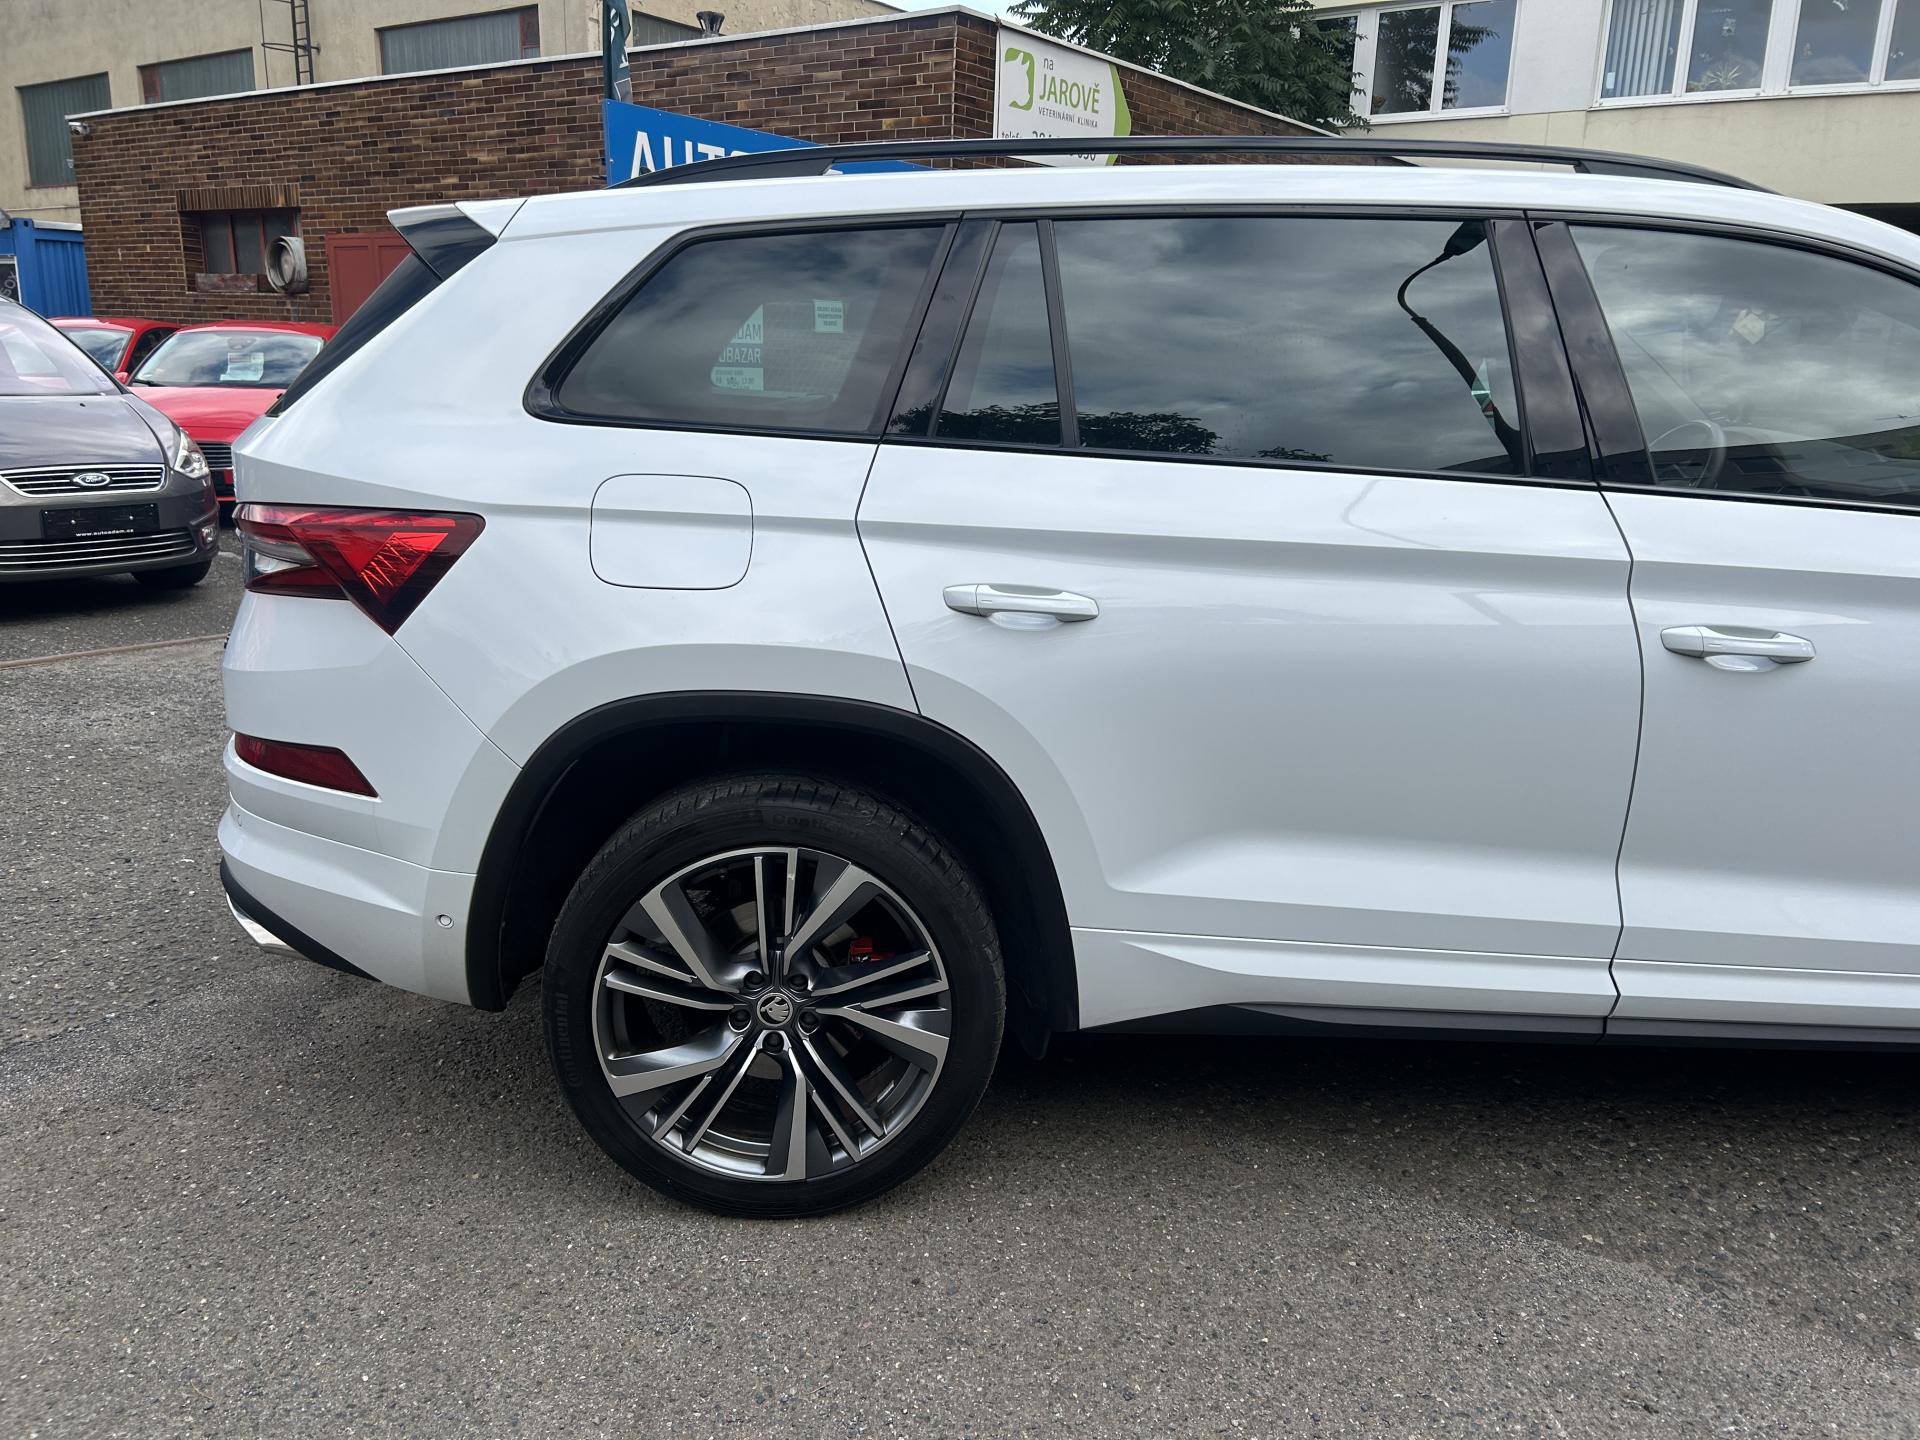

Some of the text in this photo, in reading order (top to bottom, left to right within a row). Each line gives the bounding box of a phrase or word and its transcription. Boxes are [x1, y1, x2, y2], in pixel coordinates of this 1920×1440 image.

[1043, 58, 1054, 71] na
[1039, 73, 1100, 114] JAROVĚ
[1077, 117, 1098, 128] KLINIKA
[554, 990, 584, 1088] Continental
